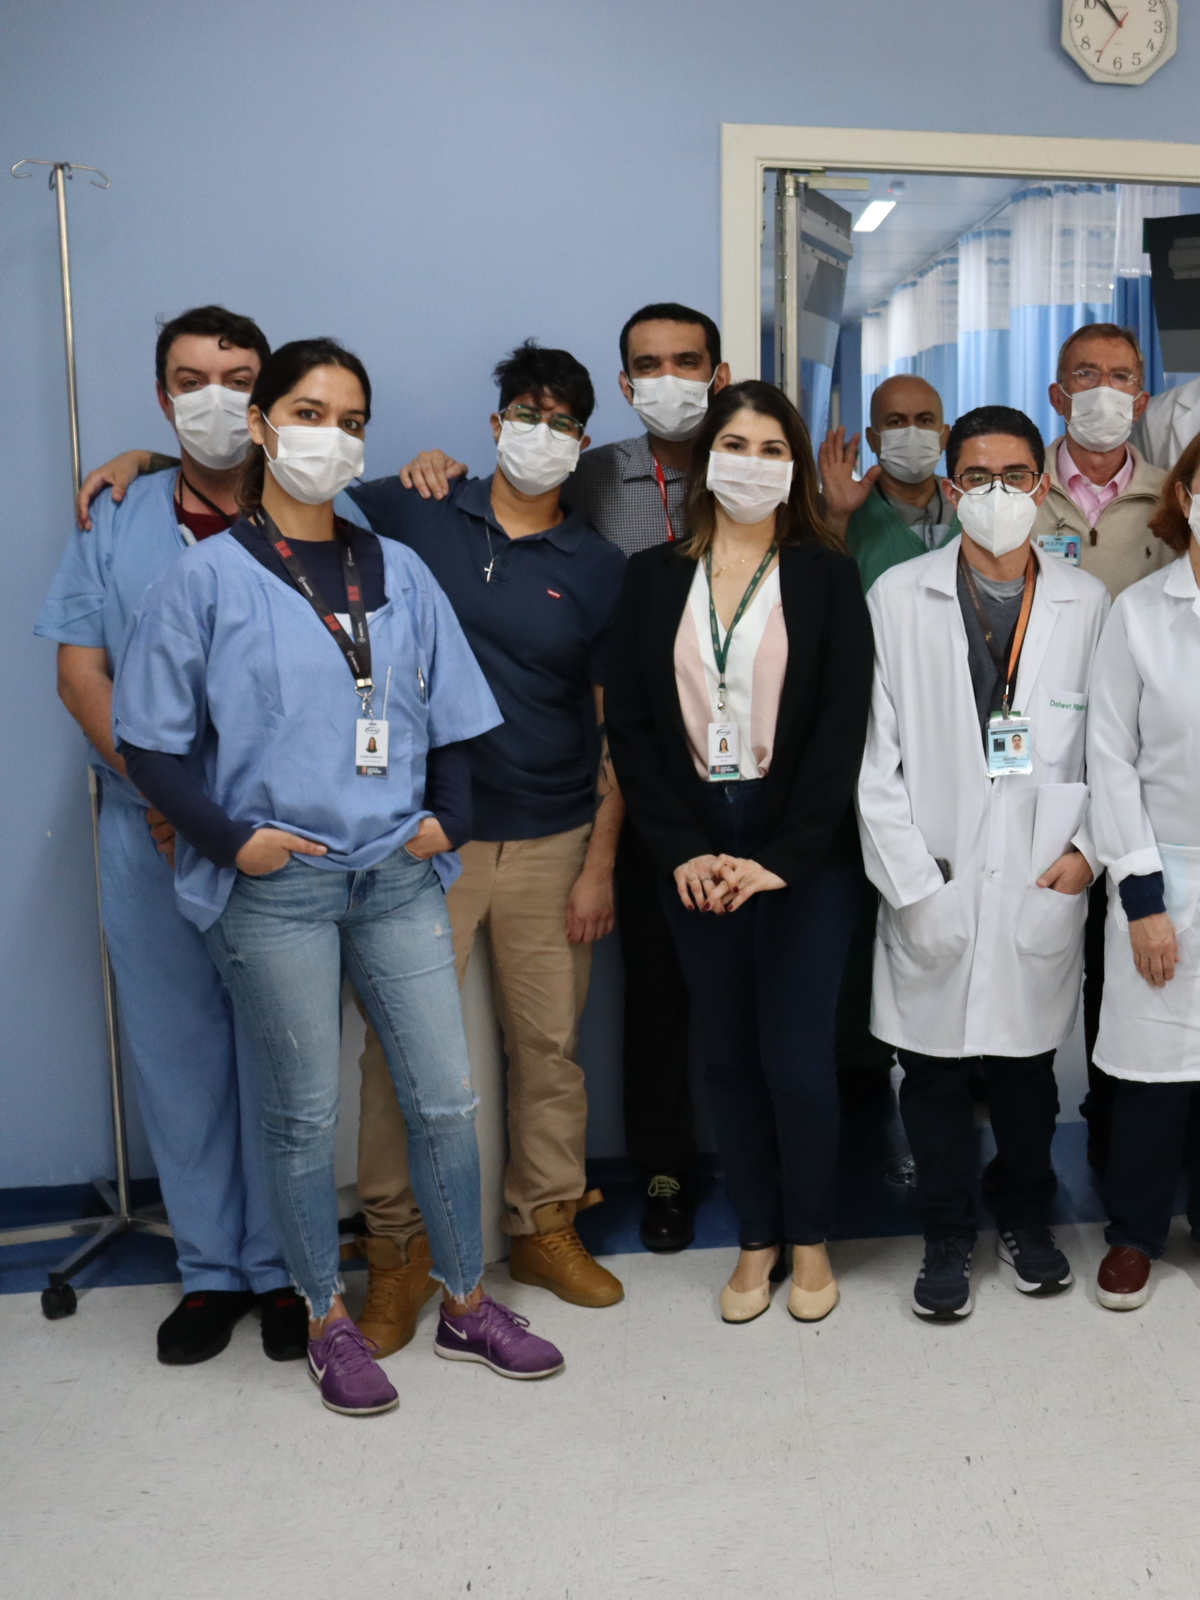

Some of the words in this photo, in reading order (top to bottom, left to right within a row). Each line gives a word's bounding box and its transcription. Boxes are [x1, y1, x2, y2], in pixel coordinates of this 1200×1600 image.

[1148, 0, 1157, 12] 2
[1074, 14, 1084, 29] 9
[1153, 20, 1163, 34] 3
[1080, 36, 1091, 50] 8
[1146, 39, 1156, 51] 4
[1094, 50, 1103, 63] 7
[1131, 52, 1142, 66] 5
[1113, 57, 1123, 71] 6
